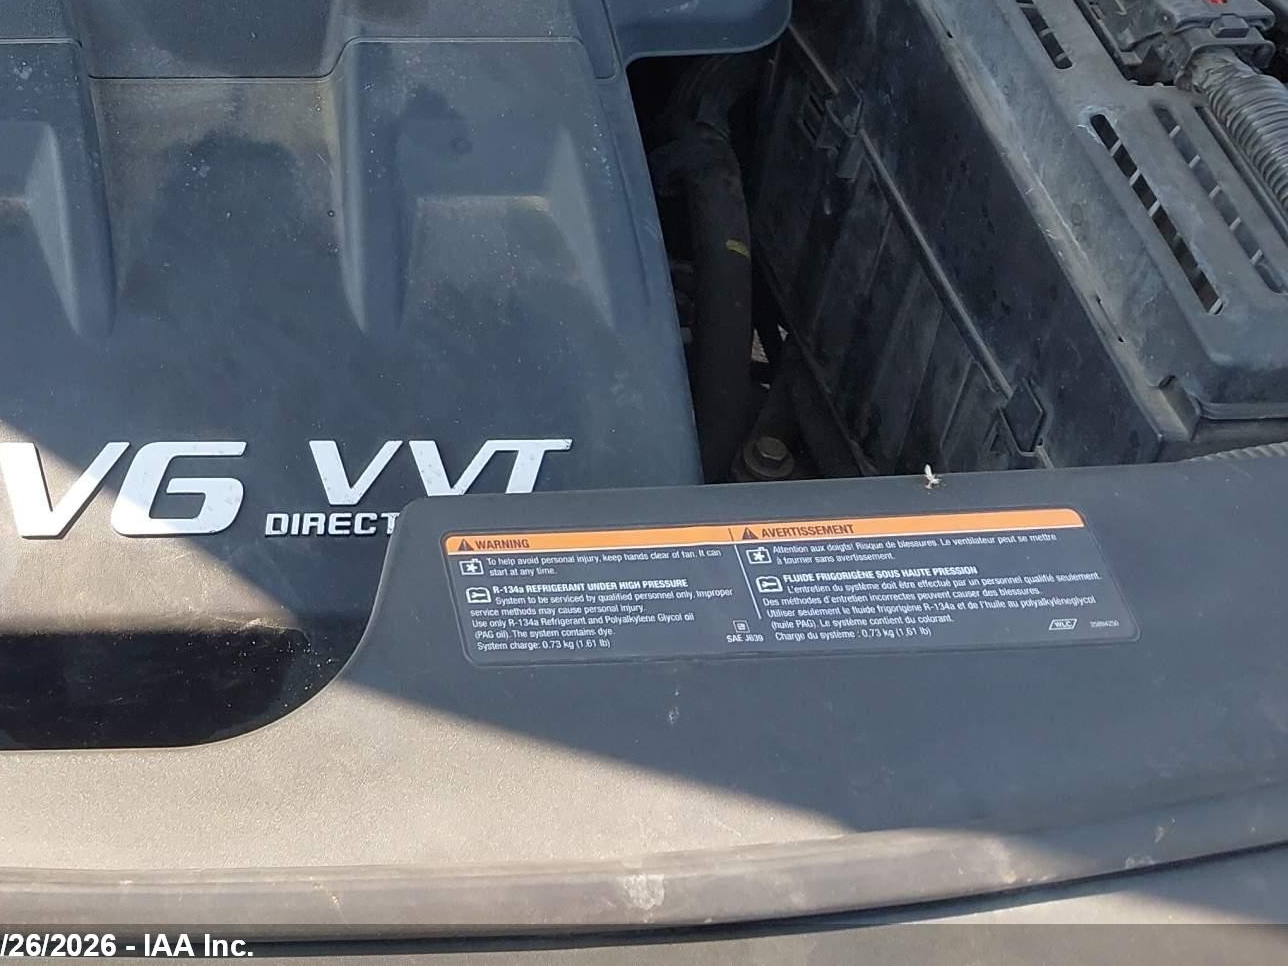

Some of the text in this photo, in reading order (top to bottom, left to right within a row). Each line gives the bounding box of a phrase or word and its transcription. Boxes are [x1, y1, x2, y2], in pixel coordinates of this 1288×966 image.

[308, 438, 572, 505] VVT
[265, 512, 398, 535] DIRECT
[761, 524, 855, 538] AVERTISSEMENT
[474, 538, 530, 550] WARNING
[773, 544, 809, 553] Attention
[856, 541, 884, 551] Risque
[952, 536, 996, 545] ventilateur
[998, 535, 1017, 545] peut
[1029, 533, 1057, 542] mettre
[499, 557, 516, 566] help
[517, 556, 539, 564] avoid
[541, 554, 575, 565] personal
[603, 553, 622, 562] keep
[623, 551, 648, 560] hands
[650, 551, 669, 559] clear
[672, 550, 680, 558] of
[698, 549, 704, 557] It
[836, 552, 895, 562] avertissement.
[489, 567, 557, 577] start at any time.
[783, 574, 814, 583] FLUIDE
[875, 570, 900, 579] SOUS
[901, 568, 931, 578] HAUTE
[933, 567, 978, 576] PRESSION
[493, 579, 689, 594] R-134a REFRIGERANT UNDER HIGH PRESSURE
[881, 581, 896, 589] doit
[952, 580, 967, 588] par
[981, 576, 1022, 587] personnel
[495, 596, 526, 606] System
[550, 594, 584, 602] serviced
[586, 593, 596, 603] by
[598, 592, 633, 603] qualified
[634, 590, 675, 601] personnel
[696, 590, 733, 599] Improper
[870, 592, 916, 602] incorrectes
[917, 591, 950, 602] peuvent
[470, 608, 499, 616] service
[501, 607, 536, 615] methods
[538, 608, 557, 616] may
[584, 604, 619, 615] personal
[620, 604, 646, 614] injury.
[767, 610, 796, 618] Utiliser
[798, 607, 840, 616] seulement
[851, 606, 876, 614] fluide
[924, 602, 955, 611] R-134a
[489, 619, 506, 629] only
[508, 618, 539, 626] R-134a
[540, 616, 586, 627] Refrigerant
[587, 616, 603, 624] and
[657, 614, 683, 624] Glycol
[684, 613, 694, 621] oil
[771, 621, 794, 631] (huile
[869, 617, 903, 625] contient
[917, 615, 955, 624] colorant.
[475, 631, 495, 641] (PAG
[512, 630, 528, 638] The
[529, 629, 560, 639] system
[561, 628, 596, 636] contains
[597, 627, 615, 637] dye.
[775, 633, 805, 642] Charge
[862, 629, 882, 637] 0.73
[883, 628, 895, 638] kg
[896, 627, 917, 638] (1.61
[919, 627, 931, 636] lb)
[477, 642, 508, 652] System
[542, 640, 562, 648] 0.73
[563, 640, 574, 650] kg
[576, 639, 597, 649] (1.61
[599, 639, 610, 648] lb)
